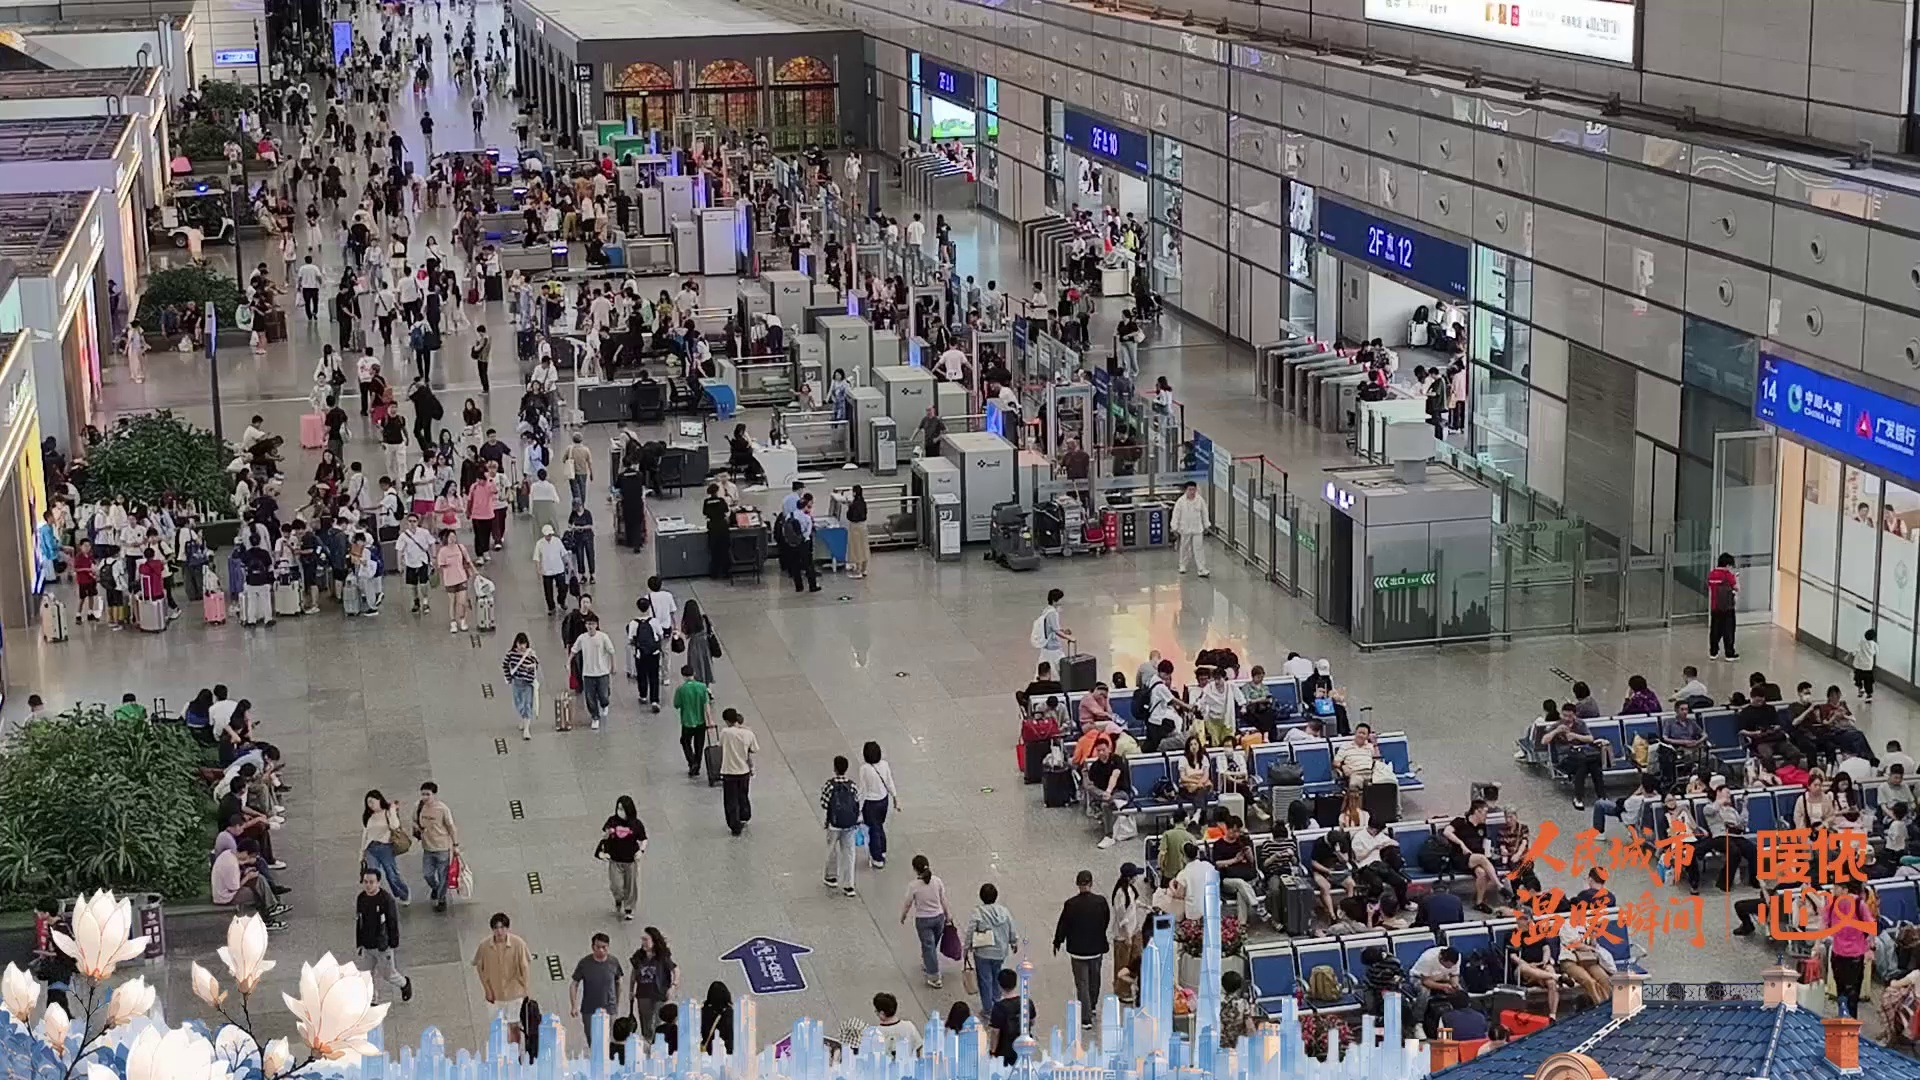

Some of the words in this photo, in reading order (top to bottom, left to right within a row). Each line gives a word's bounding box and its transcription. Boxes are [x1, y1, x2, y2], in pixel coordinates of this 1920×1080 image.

[1368, 226, 1385, 257] 2F
[1398, 237, 1412, 268] 12
[1762, 376, 1777, 403] 14
[1803, 406, 1825, 423] CHINA
[1825, 414, 1842, 428] LIFE
[1875, 416, 1917, 447] 广发银行
[1389, 576, 1405, 586] 出口
